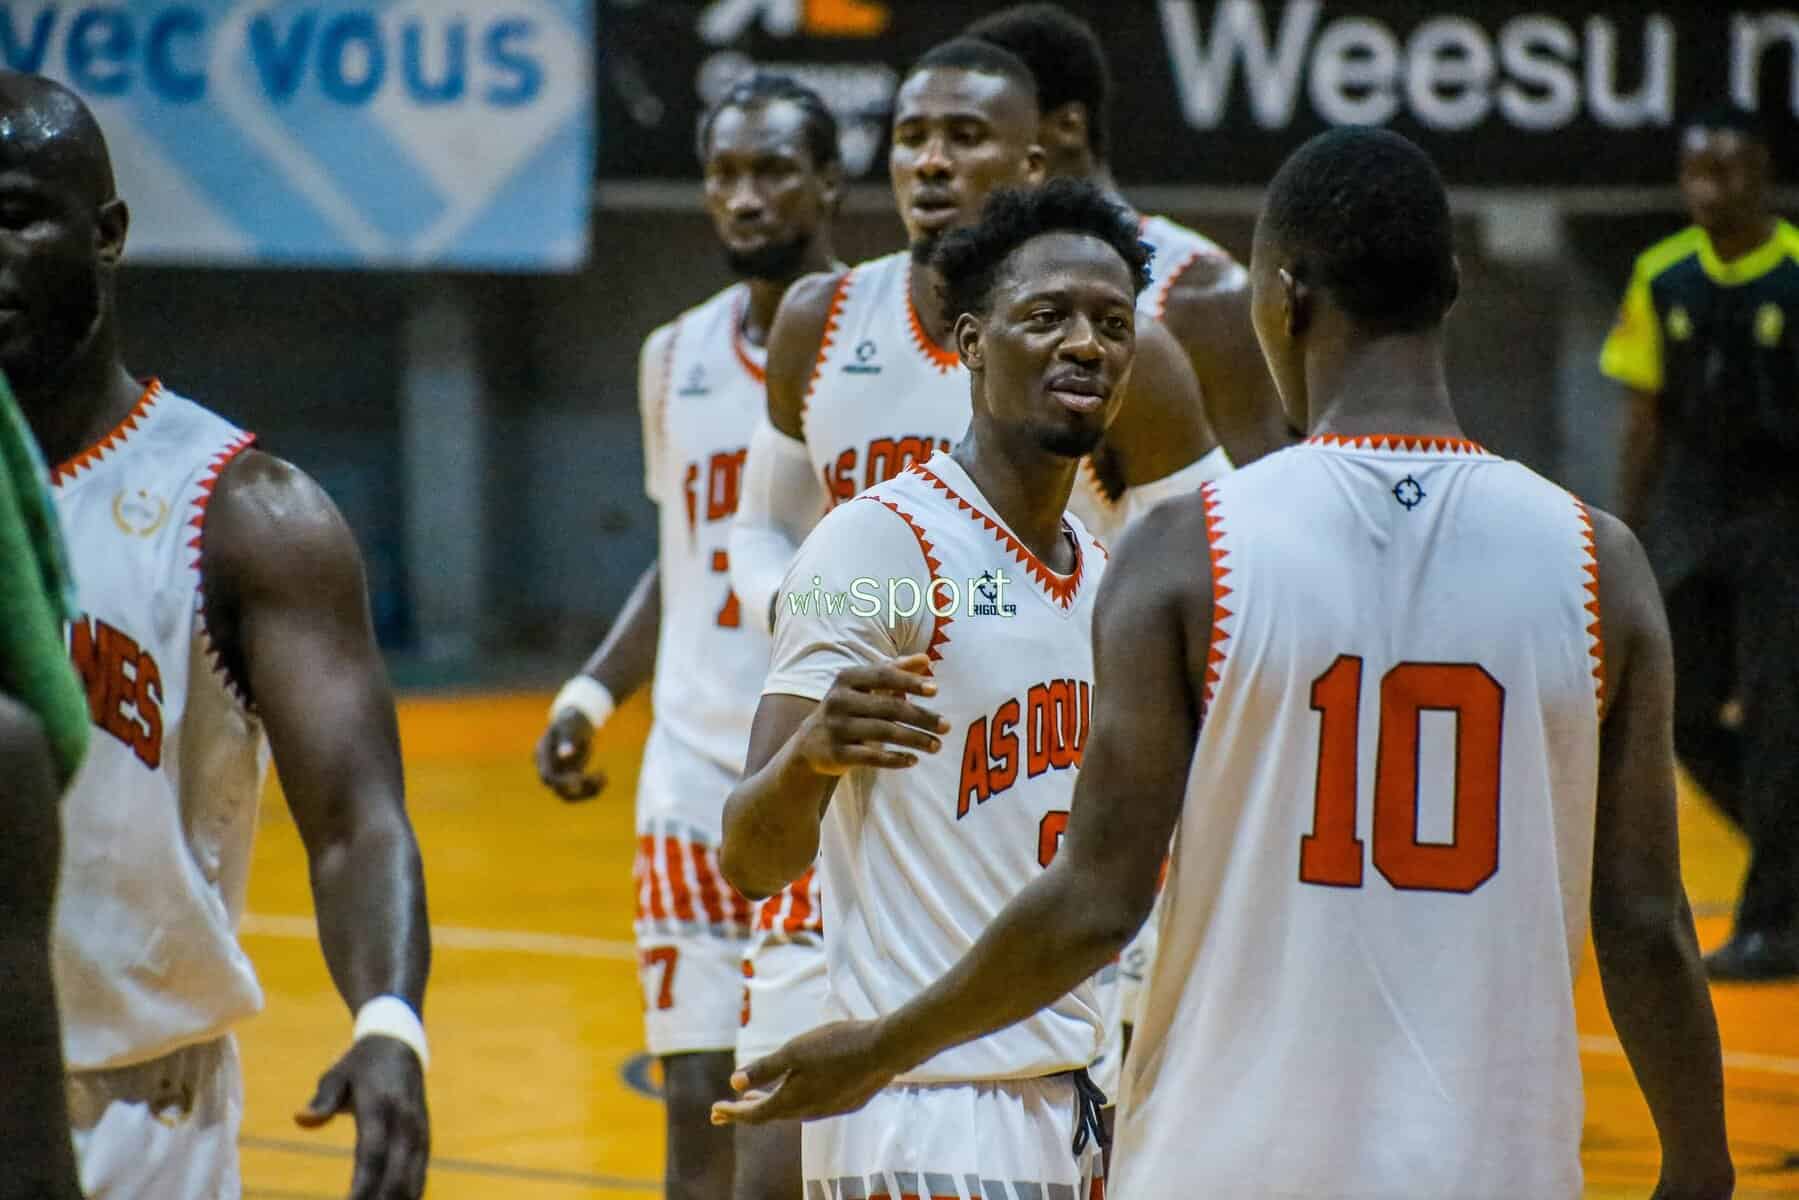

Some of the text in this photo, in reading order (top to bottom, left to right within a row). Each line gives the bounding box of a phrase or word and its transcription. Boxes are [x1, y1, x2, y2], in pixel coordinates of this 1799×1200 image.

[248, 12, 544, 107] vous
[1159, 0, 1675, 130] Weesu
[972, 604, 1017, 616] RIGOER
[956, 678, 1095, 821] AS DOU
[1299, 653, 1506, 894] 10
[644, 945, 679, 1010] 7
